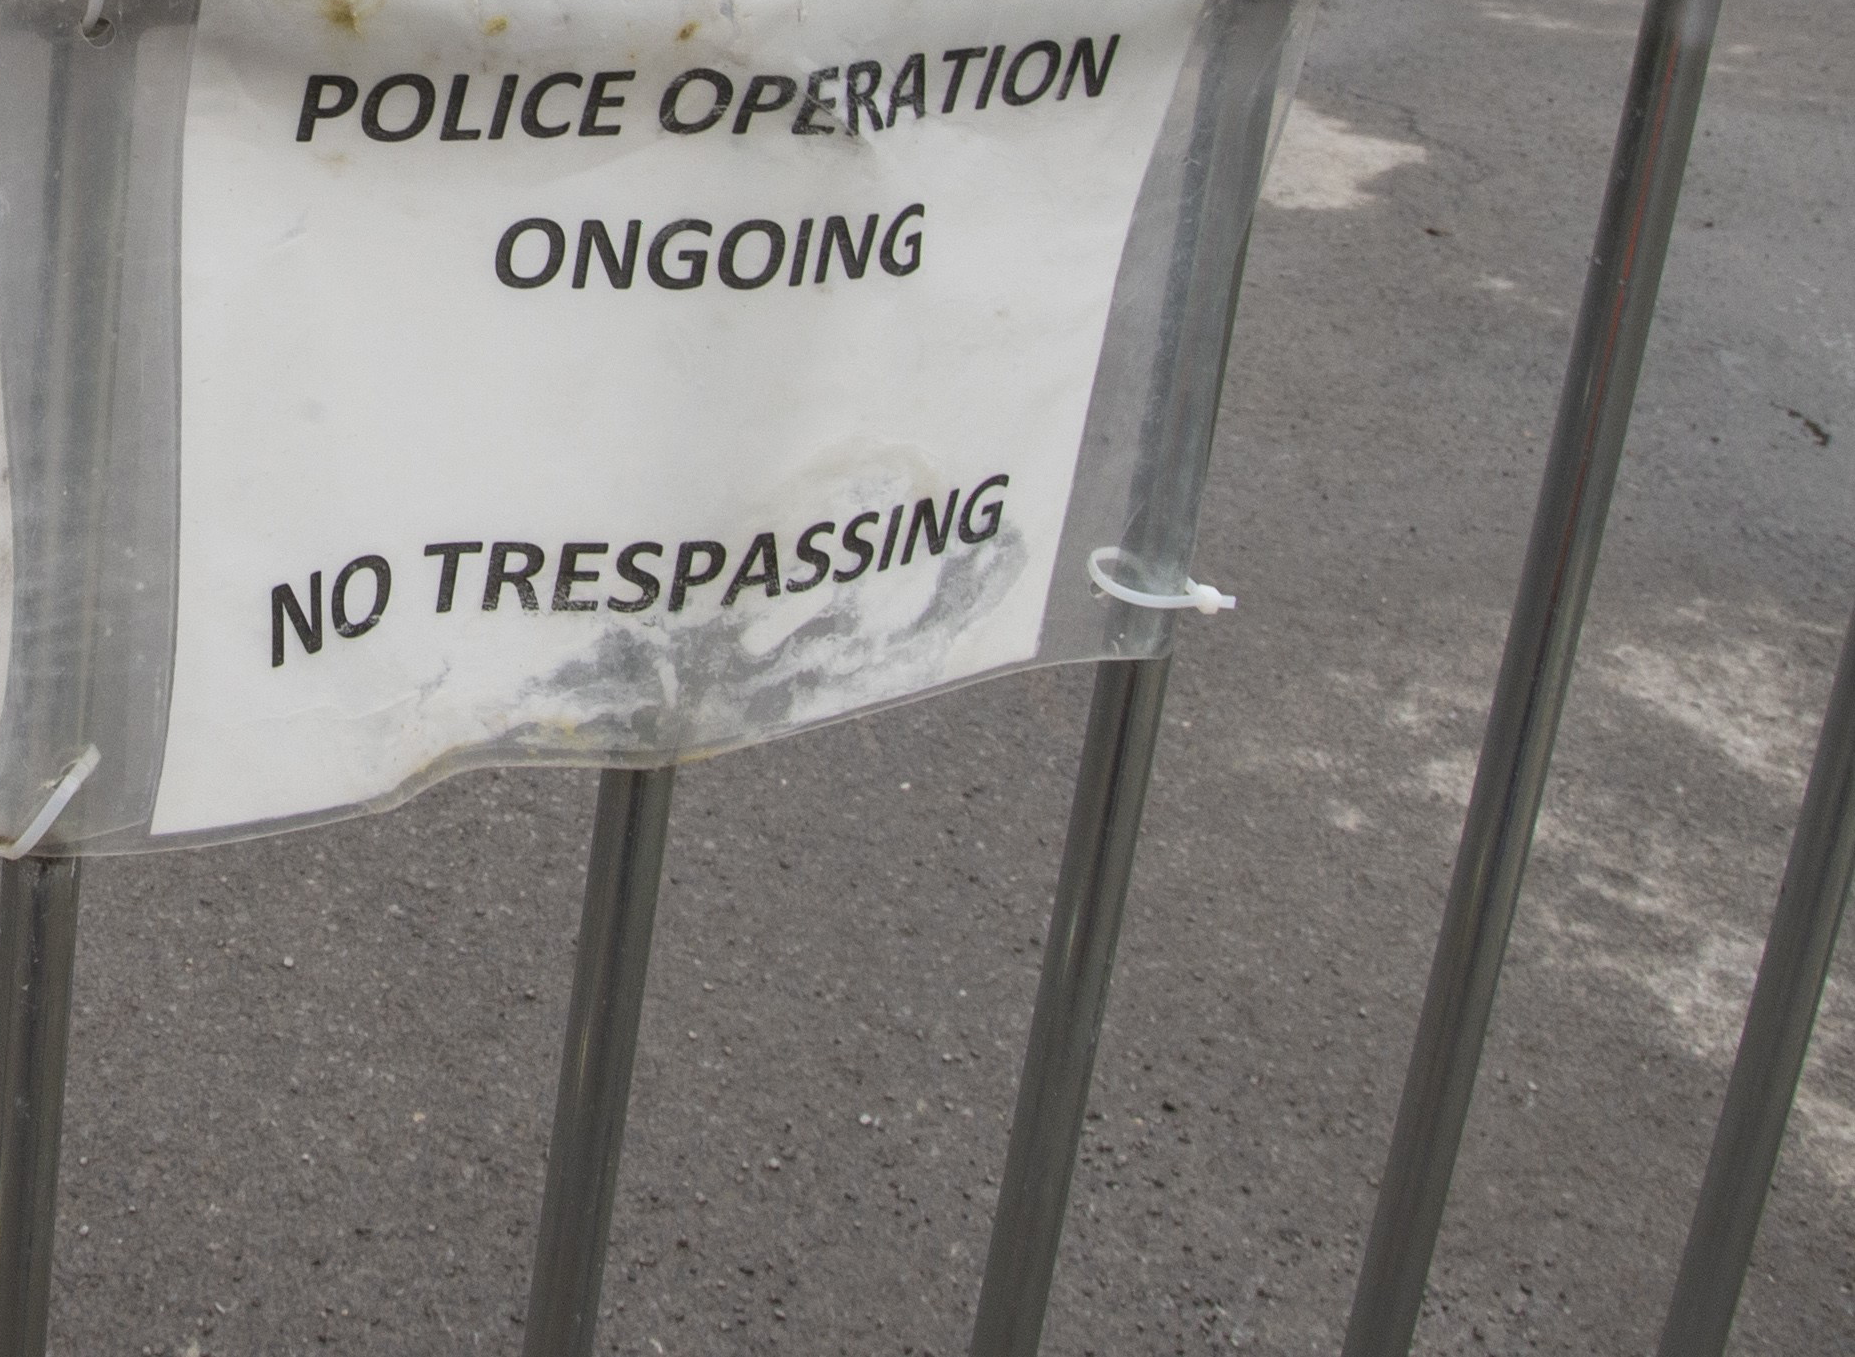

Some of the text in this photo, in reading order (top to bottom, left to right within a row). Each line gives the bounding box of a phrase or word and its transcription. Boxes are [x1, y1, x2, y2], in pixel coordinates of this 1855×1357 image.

[295, 33, 1122, 143] POLICE OPERATION
[494, 202, 926, 291] ONGOING
[270, 473, 1011, 668] NO TRESPASSING
